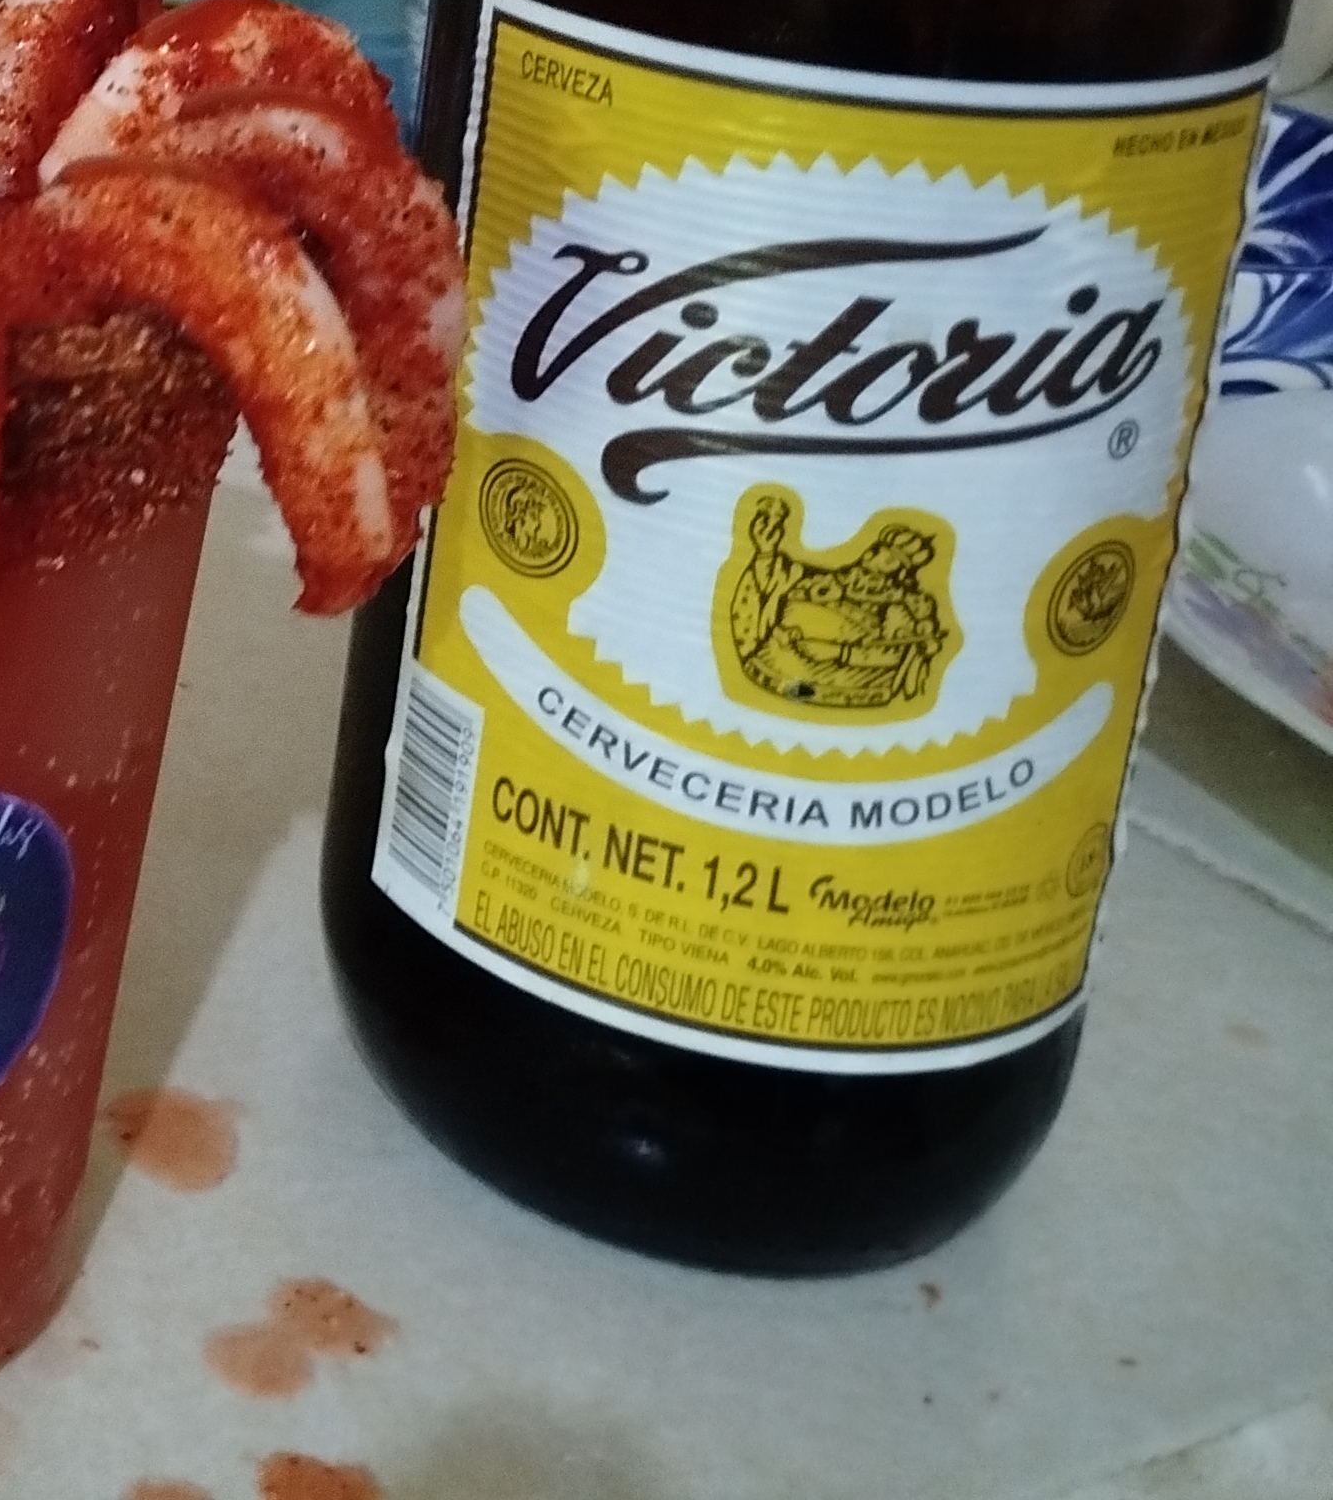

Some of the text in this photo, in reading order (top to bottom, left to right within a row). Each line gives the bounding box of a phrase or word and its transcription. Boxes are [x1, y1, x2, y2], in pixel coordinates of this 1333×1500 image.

[520, 49, 616, 107] CERVEZA
[510, 224, 1163, 500] Victoria
[538, 687, 1037, 830] CERVECERIA MODELO
[492, 776, 790, 915] CONT. NET. 1,2 L
[473, 890, 491, 931] EL
[496, 904, 555, 962] ABUSO
[557, 931, 582, 976] EN
[586, 944, 610, 987] EL
[614, 953, 717, 1019] CONSUMO
[720, 982, 751, 1025] DE
[752, 987, 805, 1029] ESTE
[806, 996, 911, 1037] PRODUCTO
